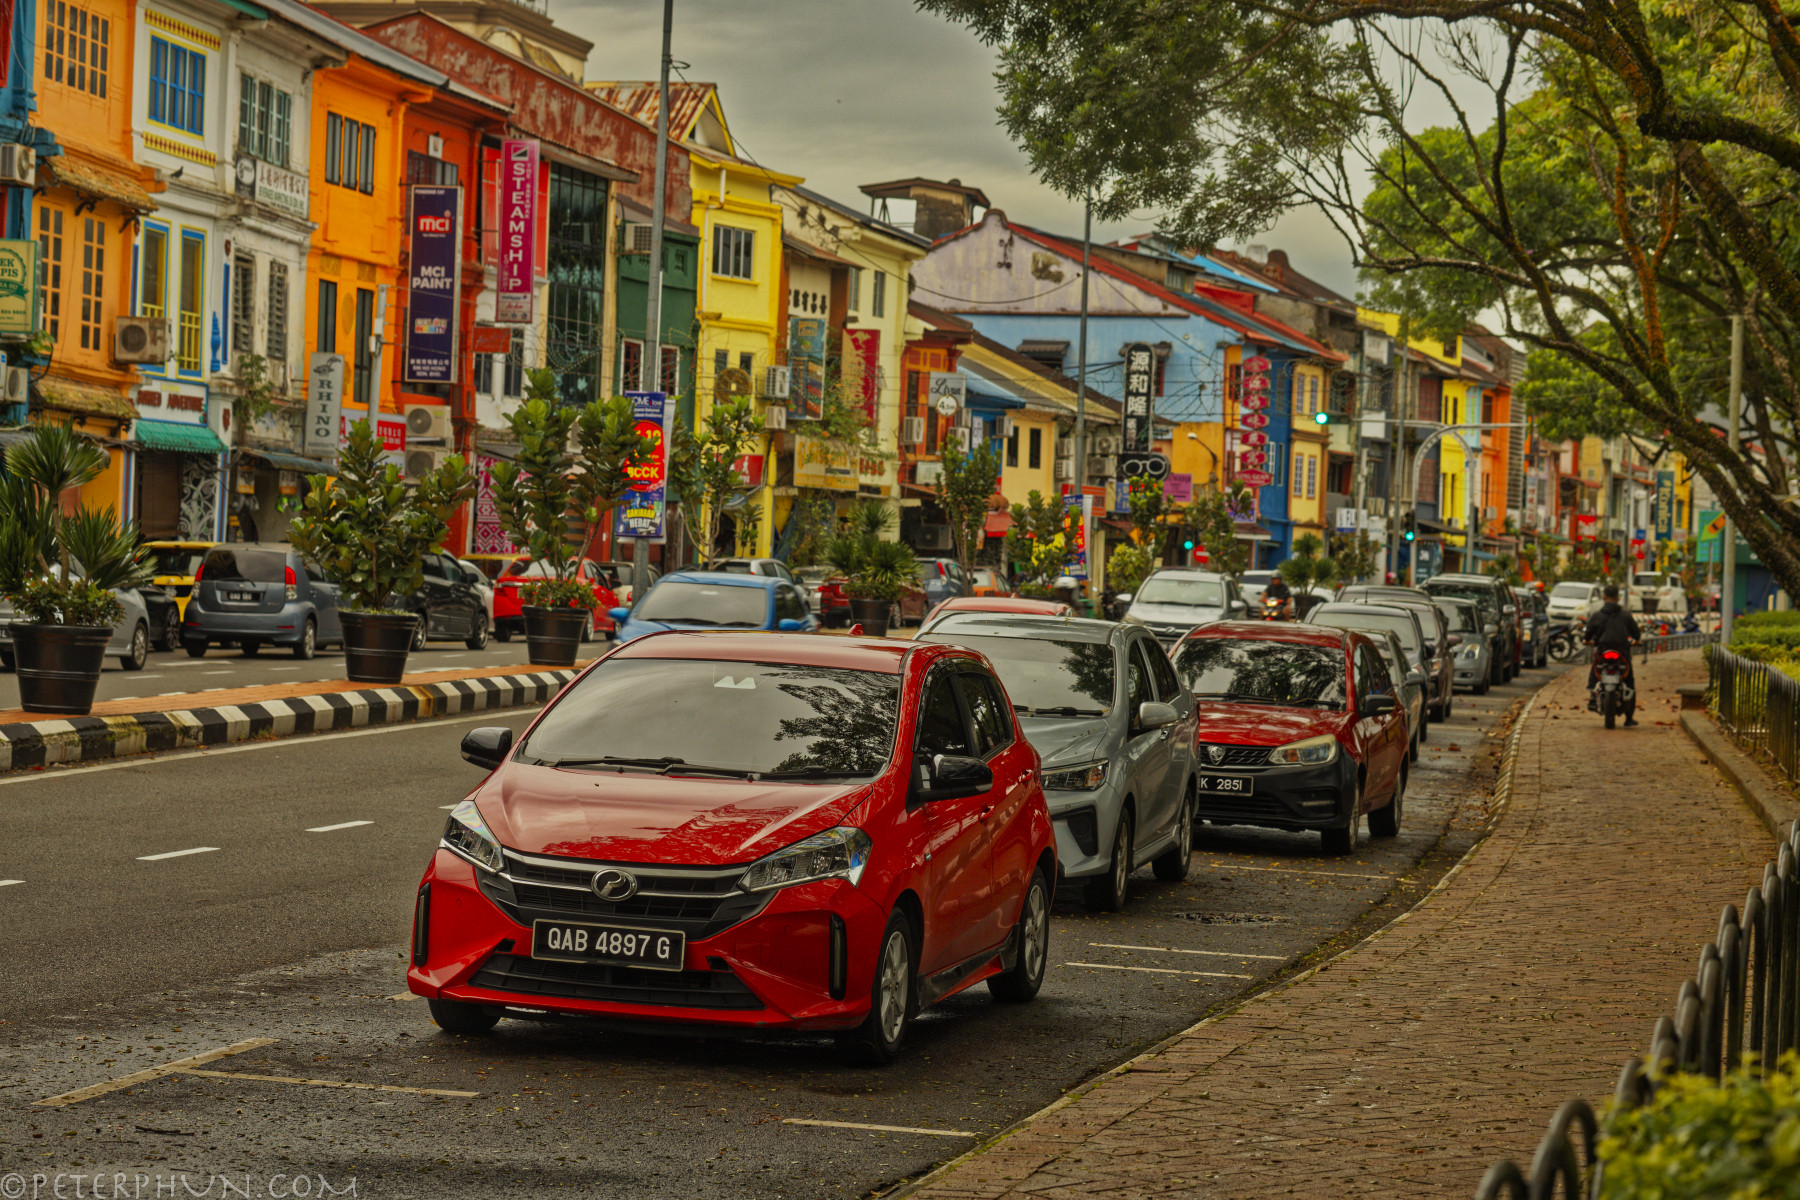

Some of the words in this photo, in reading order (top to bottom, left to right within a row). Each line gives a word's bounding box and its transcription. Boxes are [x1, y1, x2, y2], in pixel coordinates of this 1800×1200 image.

[508, 162, 525, 291] STEAMSHIP
[421, 266, 445, 277] MCI
[412, 277, 452, 289] PAINT
[1127, 351, 1150, 416] 源和隆
[315, 379, 333, 438] RHINO
[630, 395, 650, 406] OME
[1216, 778, 1243, 790] 2851
[548, 927, 588, 951] QAB
[595, 931, 650, 957] 4897
[656, 936, 670, 959] G
